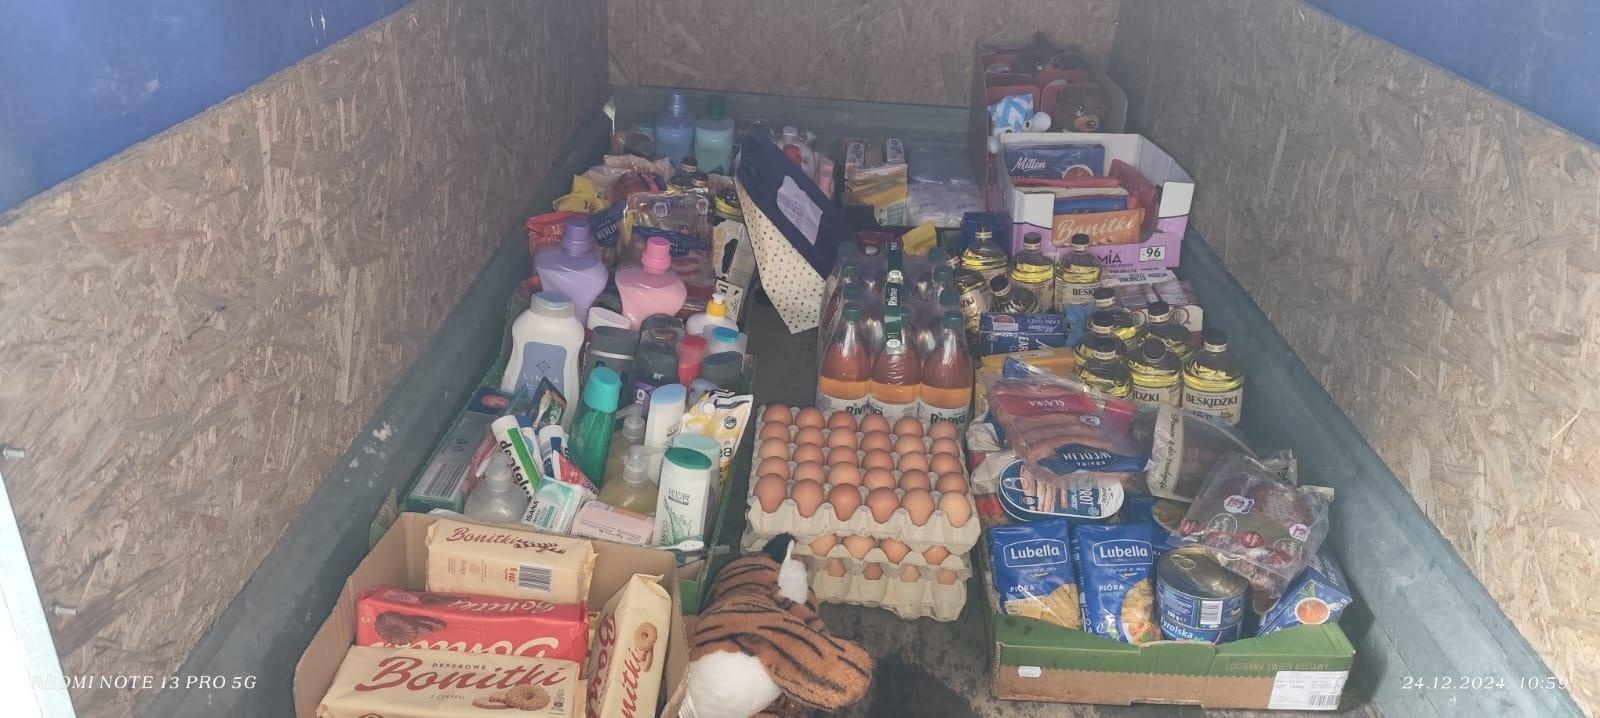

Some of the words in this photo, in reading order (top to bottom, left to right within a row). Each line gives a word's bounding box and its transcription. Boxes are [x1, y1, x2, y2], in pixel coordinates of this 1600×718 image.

[1053, 215, 1136, 243] Bonitki
[1185, 392, 1238, 408] BESKIDZKI
[525, 499, 540, 522] ISANA
[446, 526, 519, 546] Bonitki
[1010, 544, 1060, 560] Lubella
[1099, 545, 1149, 559] Lubella
[1098, 583, 1125, 592] PIÓRA
[1160, 616, 1194, 639] Tyrolska
[354, 655, 569, 692] Bonitki
[431, 662, 487, 671] DESEROWE
